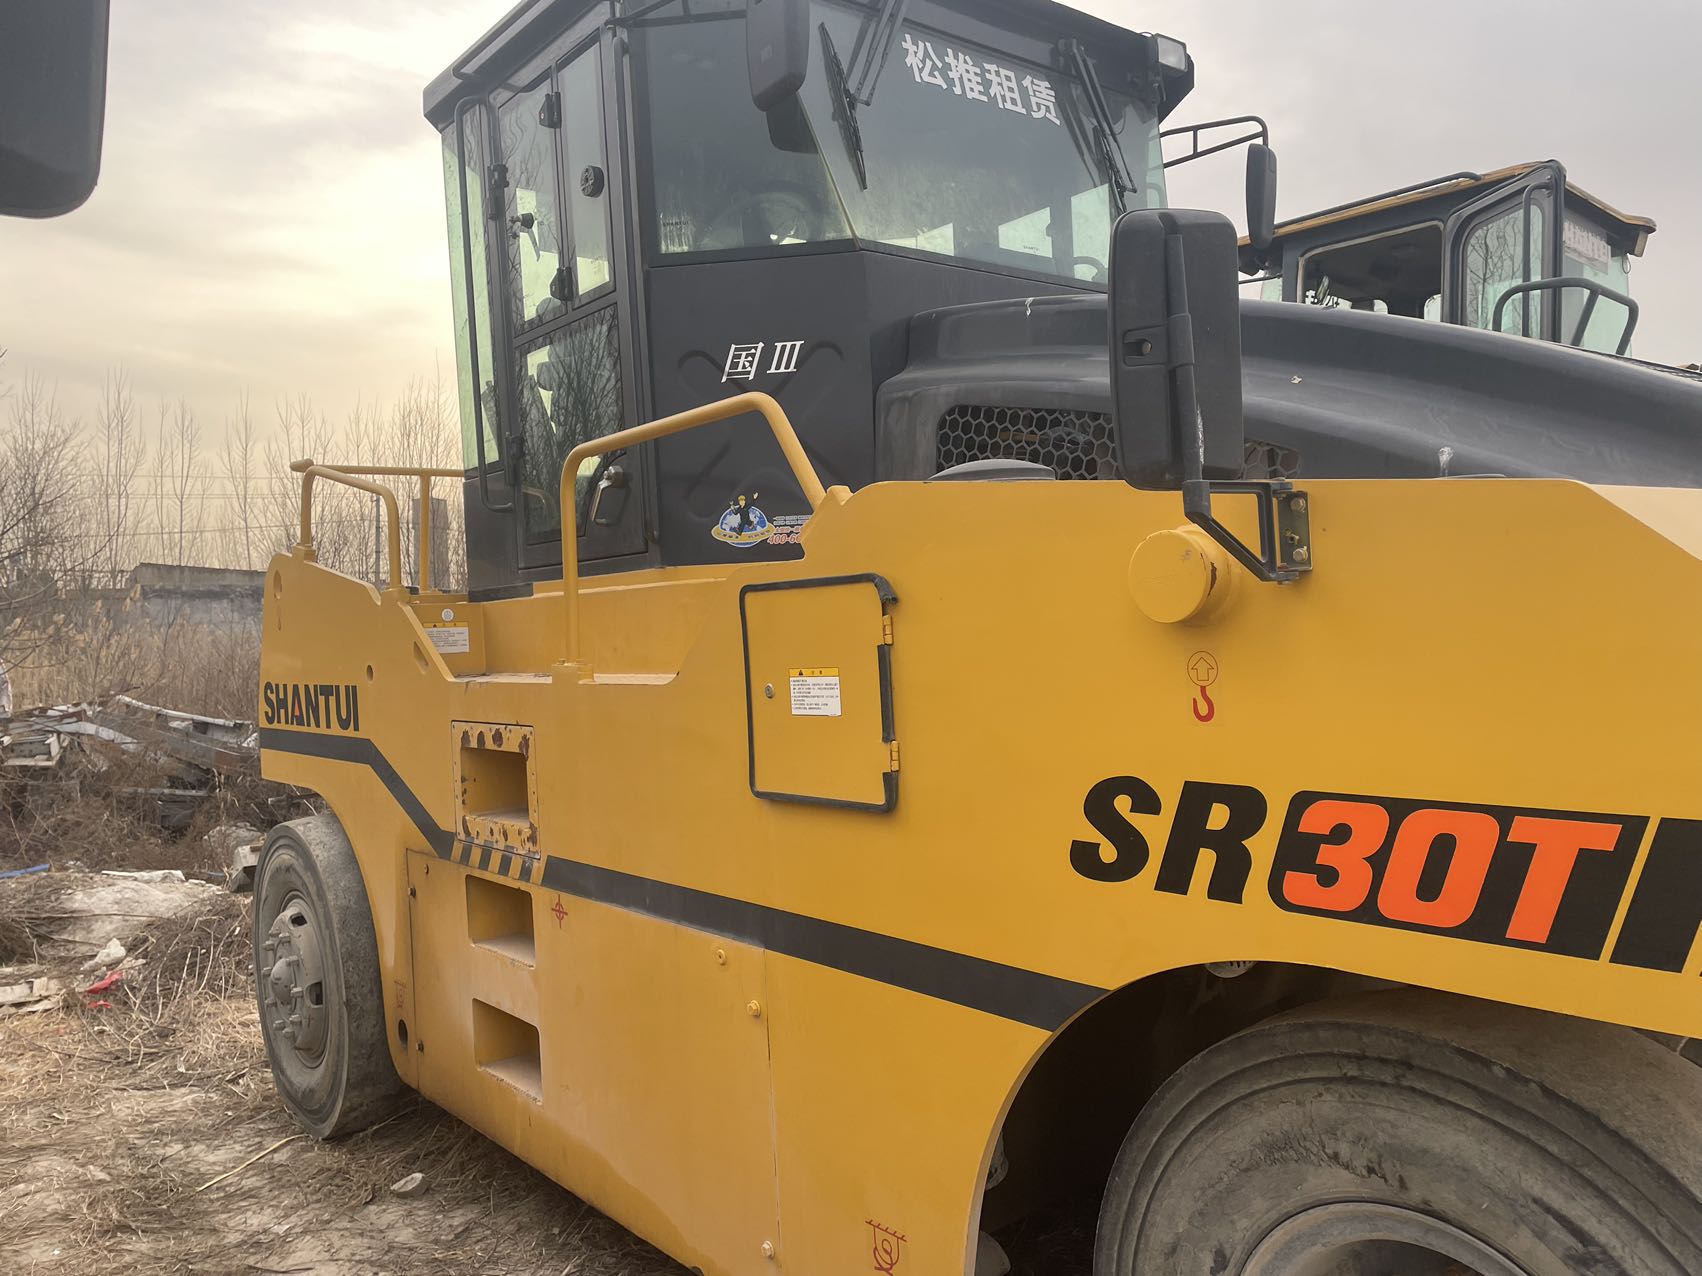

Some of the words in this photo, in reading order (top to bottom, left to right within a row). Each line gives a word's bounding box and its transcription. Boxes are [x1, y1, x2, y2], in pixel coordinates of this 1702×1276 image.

[901, 33, 1061, 126] 松推租赁
[263, 681, 360, 732] SHANTUI
[1069, 775, 1623, 944] SR30T
